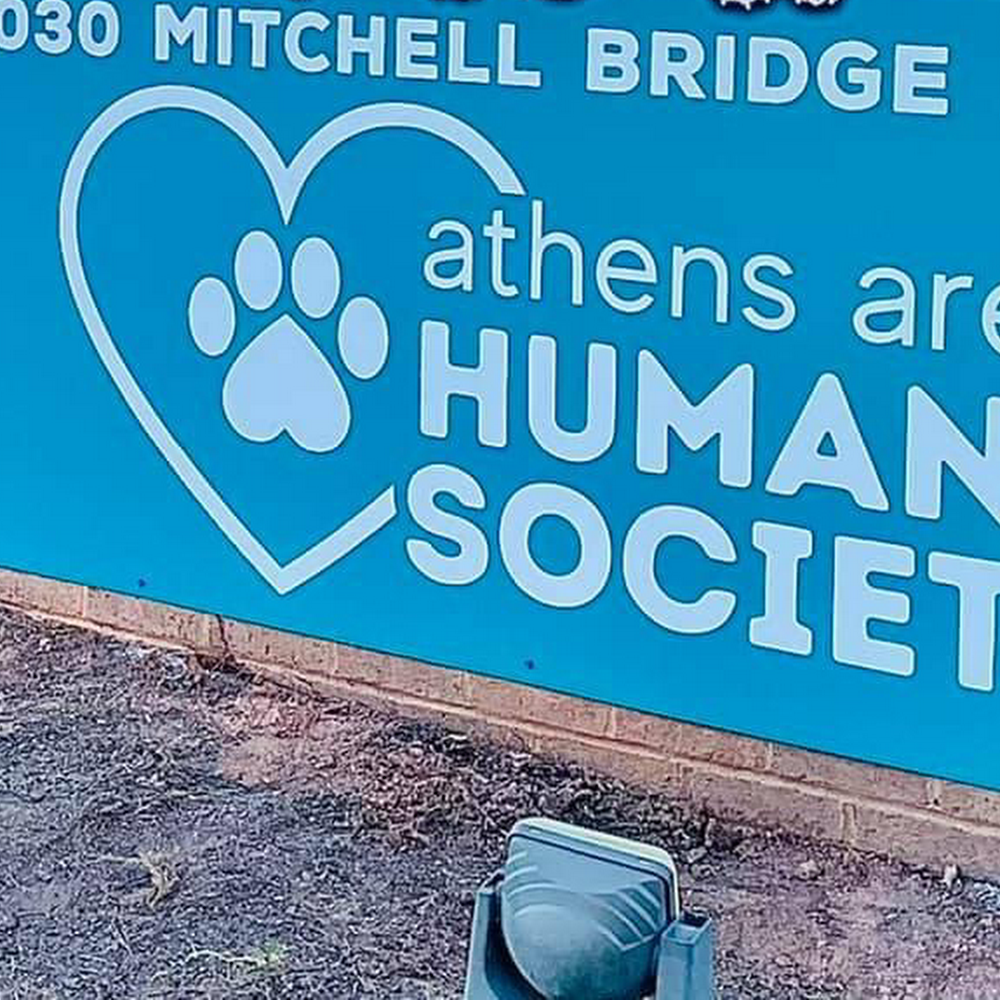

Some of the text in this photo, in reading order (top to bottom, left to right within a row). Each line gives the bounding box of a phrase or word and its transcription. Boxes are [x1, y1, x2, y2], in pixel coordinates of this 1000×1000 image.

[153, 3, 542, 88] MITCHELL
[584, 27, 950, 116] BRIDGE
[421, 199, 1000, 354] athens ar
[418, 319, 1000, 525] HUMAN
[404, 463, 1000, 693] SOCIET
